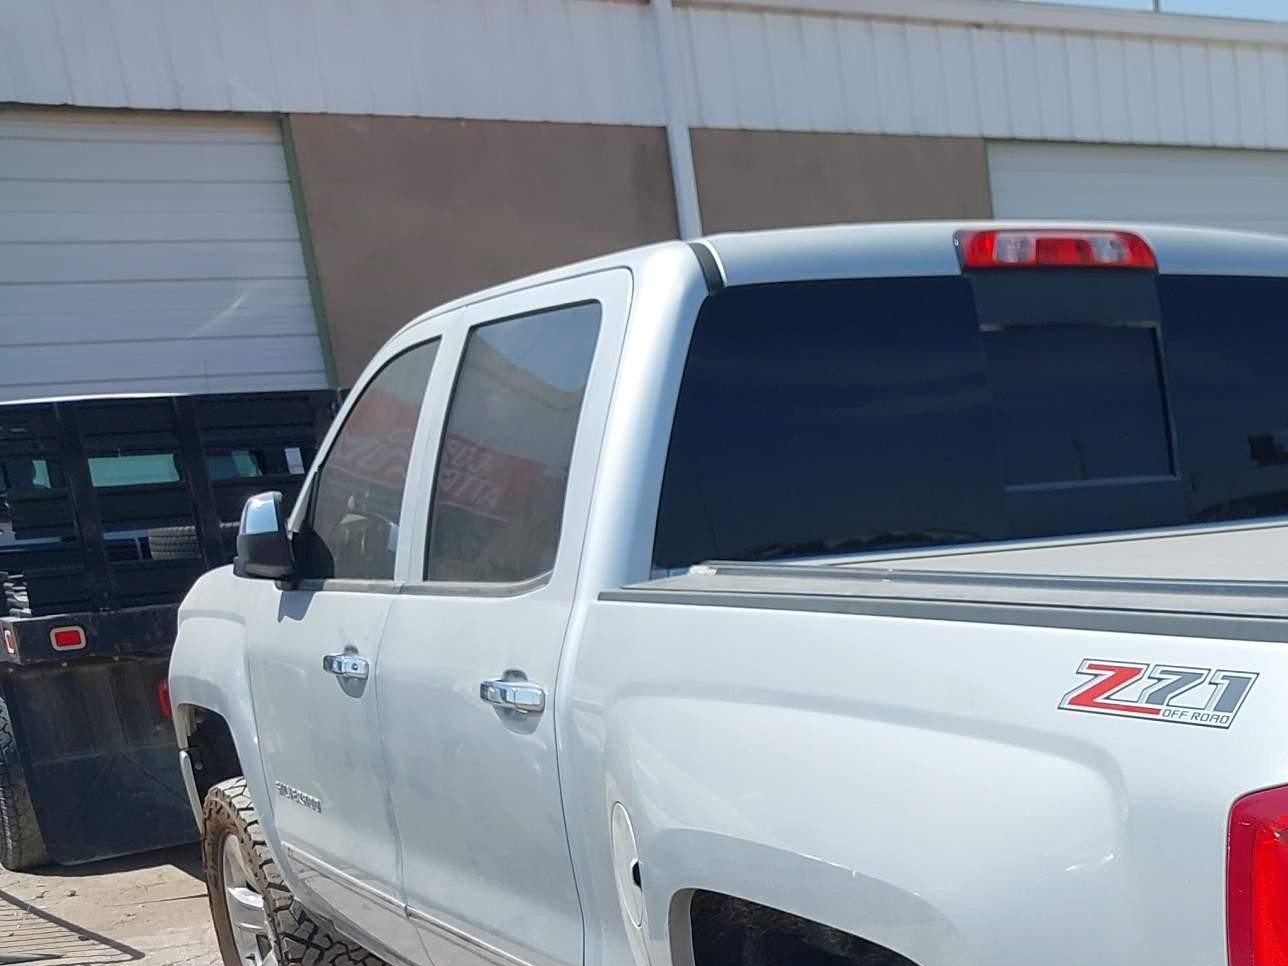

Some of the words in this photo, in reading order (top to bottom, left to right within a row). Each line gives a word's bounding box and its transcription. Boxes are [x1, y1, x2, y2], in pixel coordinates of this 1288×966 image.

[1057, 657, 1260, 727] Z71
[1162, 708, 1189, 719] OFF
[1190, 711, 1231, 724] ROAD
